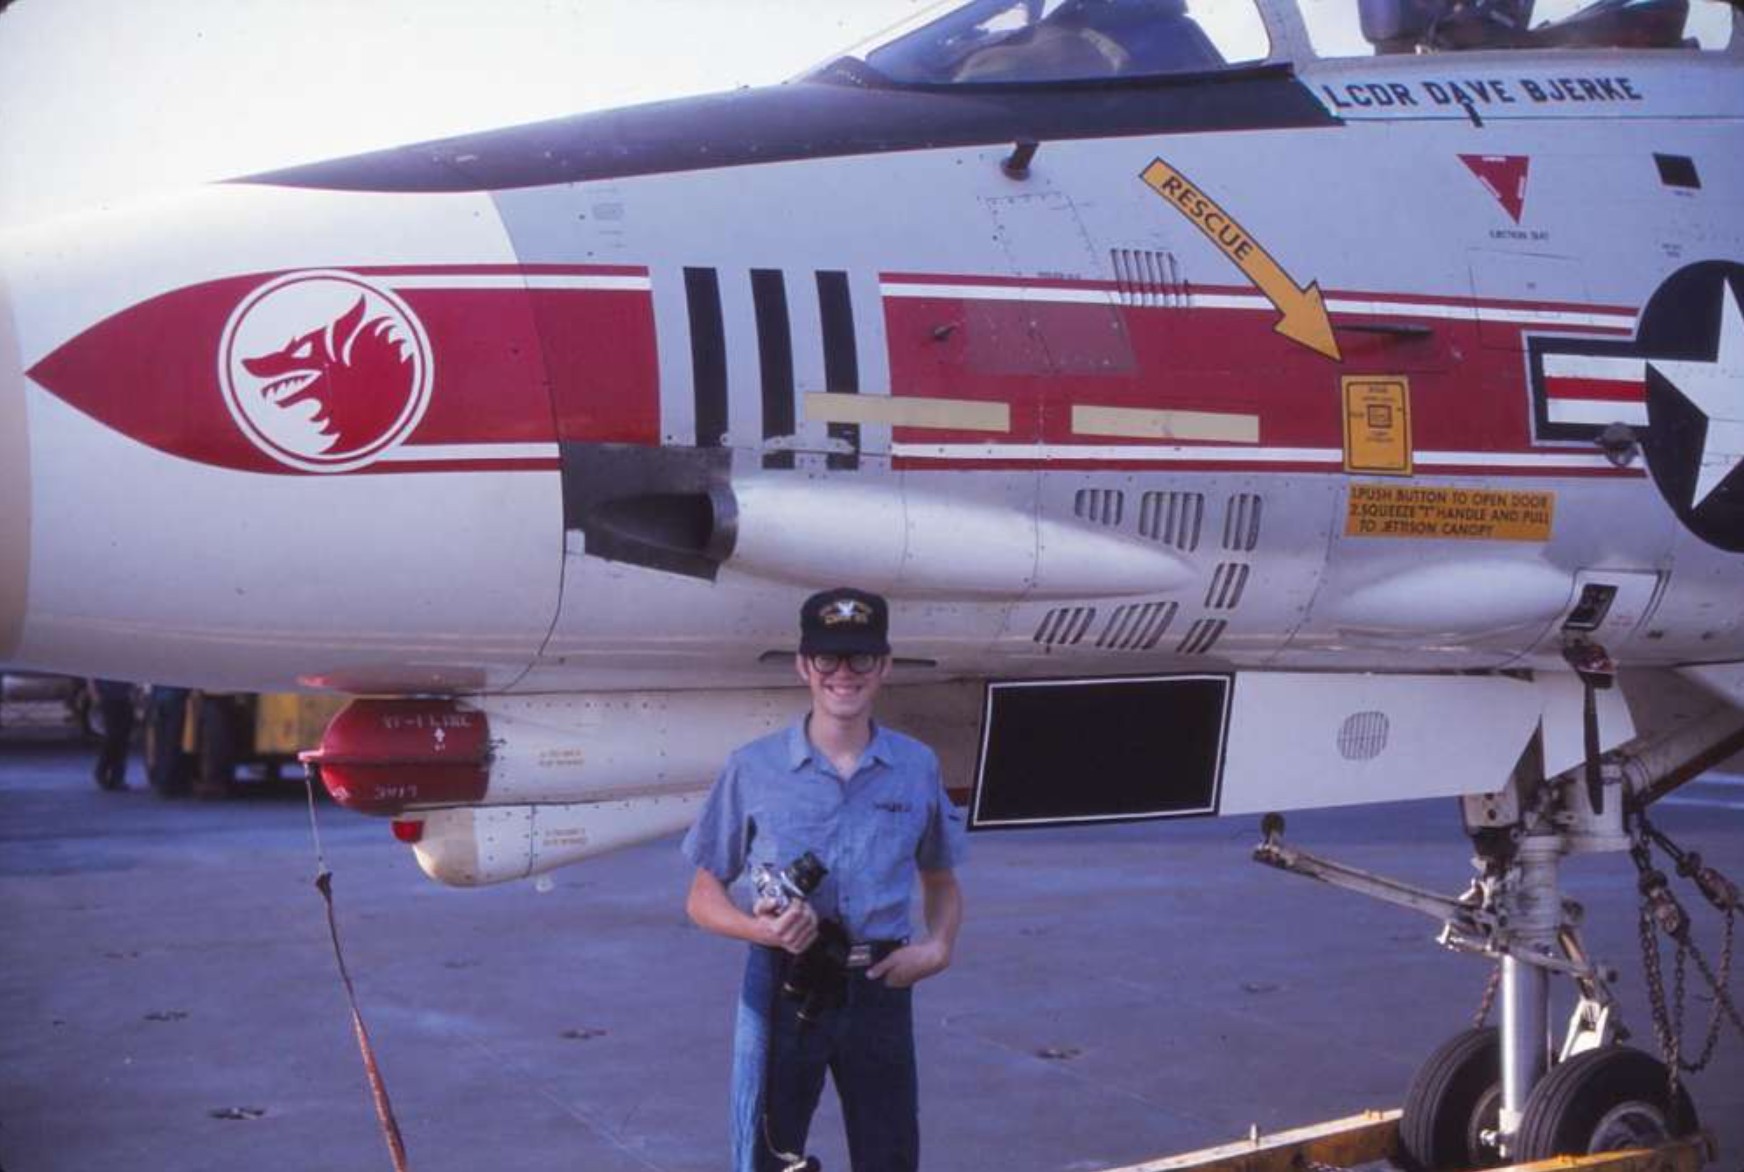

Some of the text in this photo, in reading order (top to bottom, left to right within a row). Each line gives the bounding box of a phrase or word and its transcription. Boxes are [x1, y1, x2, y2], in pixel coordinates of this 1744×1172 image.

[1322, 77, 1643, 107] LCDR DAVE BJERKE
[1162, 175, 1255, 262] RESCUE
[1397, 489, 1446, 503] BUTTON
[1453, 491, 1467, 504] TO
[1473, 492, 1507, 507] OPEN
[1512, 494, 1547, 508] DOOR
[1438, 506, 1486, 521] HANDLE
[1491, 508, 1519, 522] AND
